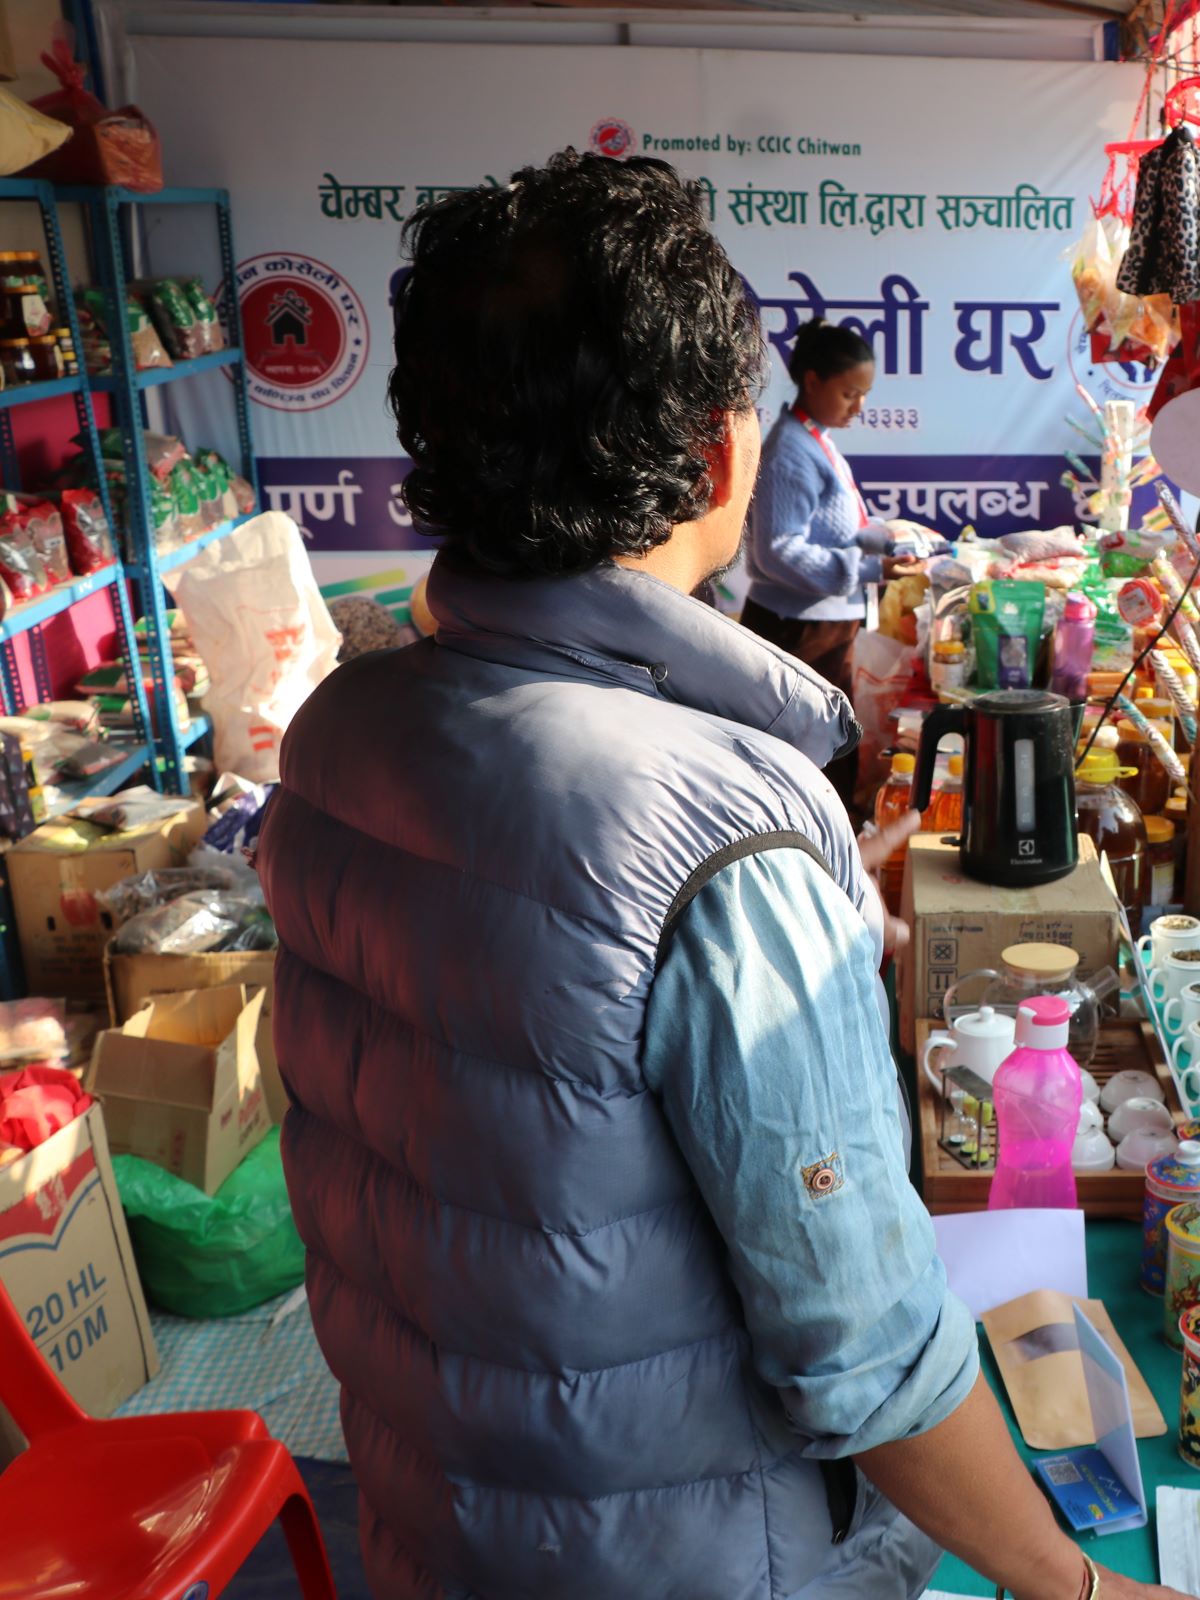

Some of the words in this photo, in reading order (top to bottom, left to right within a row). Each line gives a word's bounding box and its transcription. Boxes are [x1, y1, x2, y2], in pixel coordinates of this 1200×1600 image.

[643, 134, 720, 151] Promoted
[727, 134, 751, 156] by:
[757, 136, 791, 154] CCIC
[797, 137, 861, 155] Chitwan
[318, 172, 405, 222] चेम्बर
[728, 181, 808, 226] संस्था
[954, 301, 1060, 380] घर
[860, 481, 1049, 525] उपलब्ध
[67, 1262, 107, 1309] HL
[49, 1305, 109, 1372] 10M
